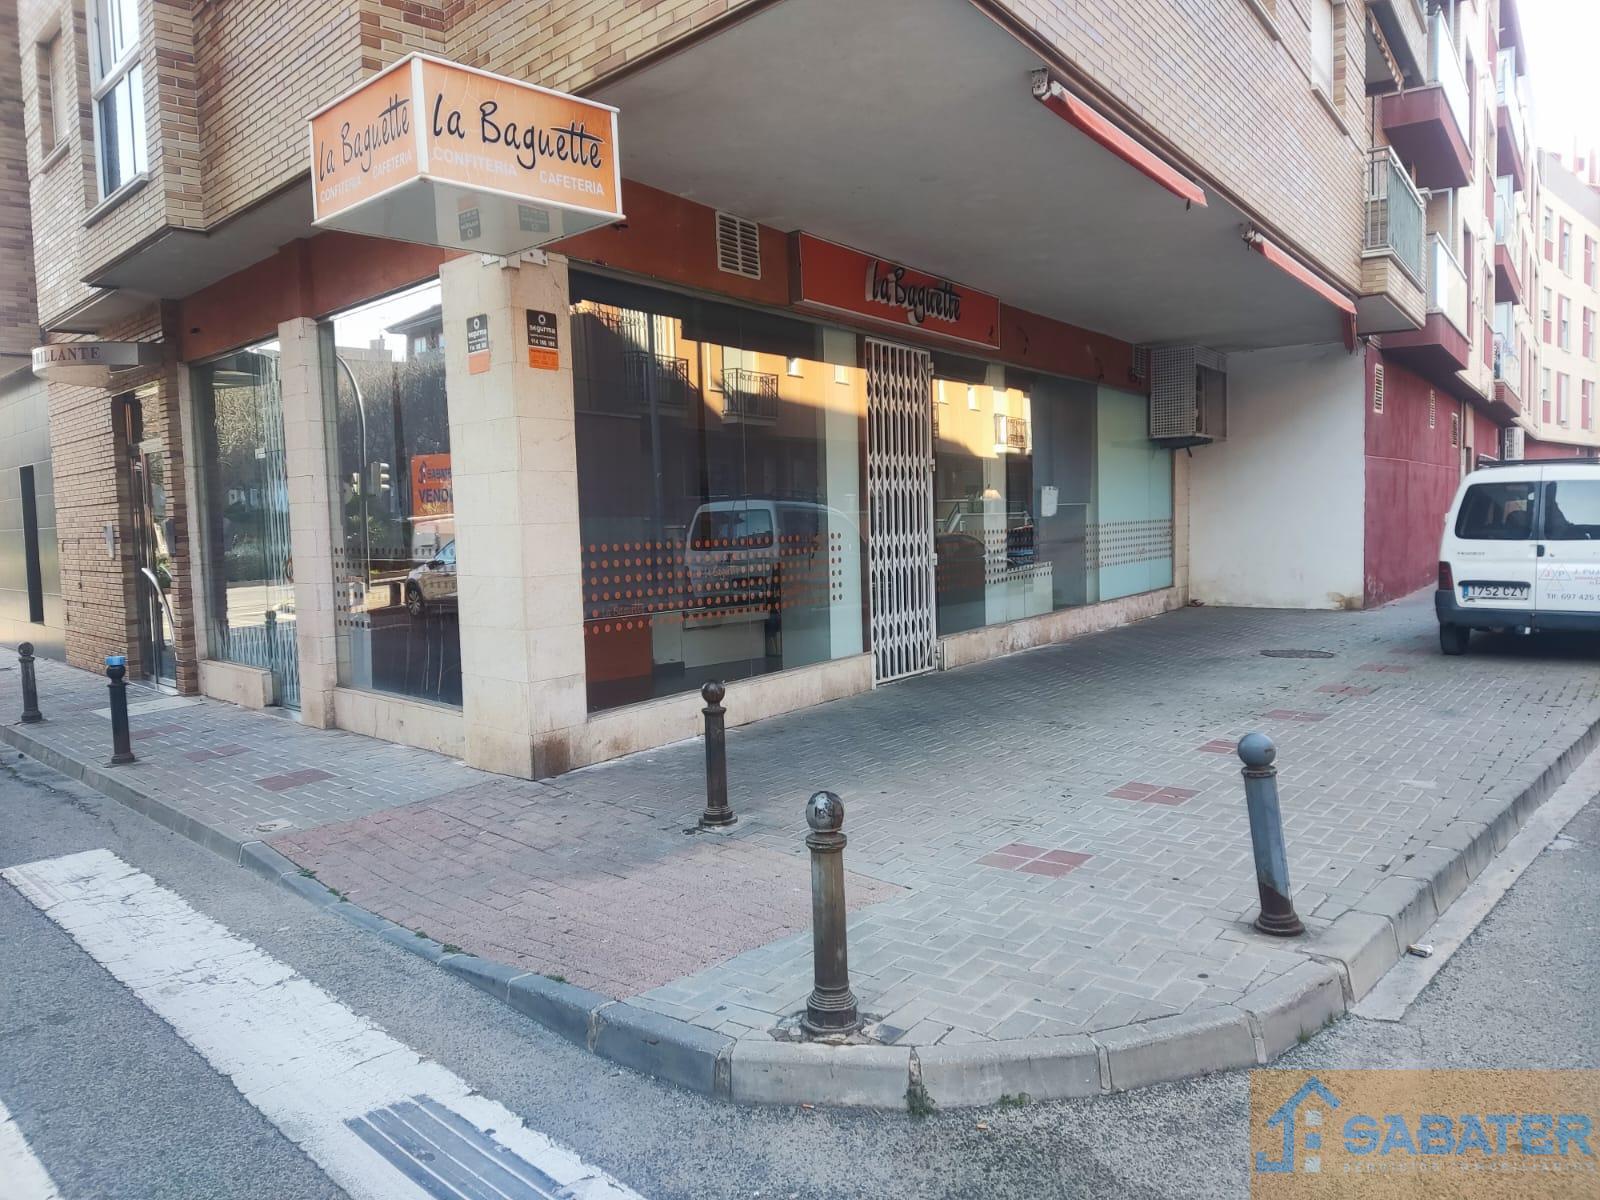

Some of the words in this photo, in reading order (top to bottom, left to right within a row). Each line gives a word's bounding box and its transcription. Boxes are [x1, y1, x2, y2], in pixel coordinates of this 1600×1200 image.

[341, 93, 410, 173] Baguette
[479, 101, 603, 170] Baguette
[432, 147, 517, 177] CONFITERIA
[539, 170, 605, 196] CAFETERIA
[893, 266, 962, 324] Baguette
[1502, 586, 1526, 597] CZY
